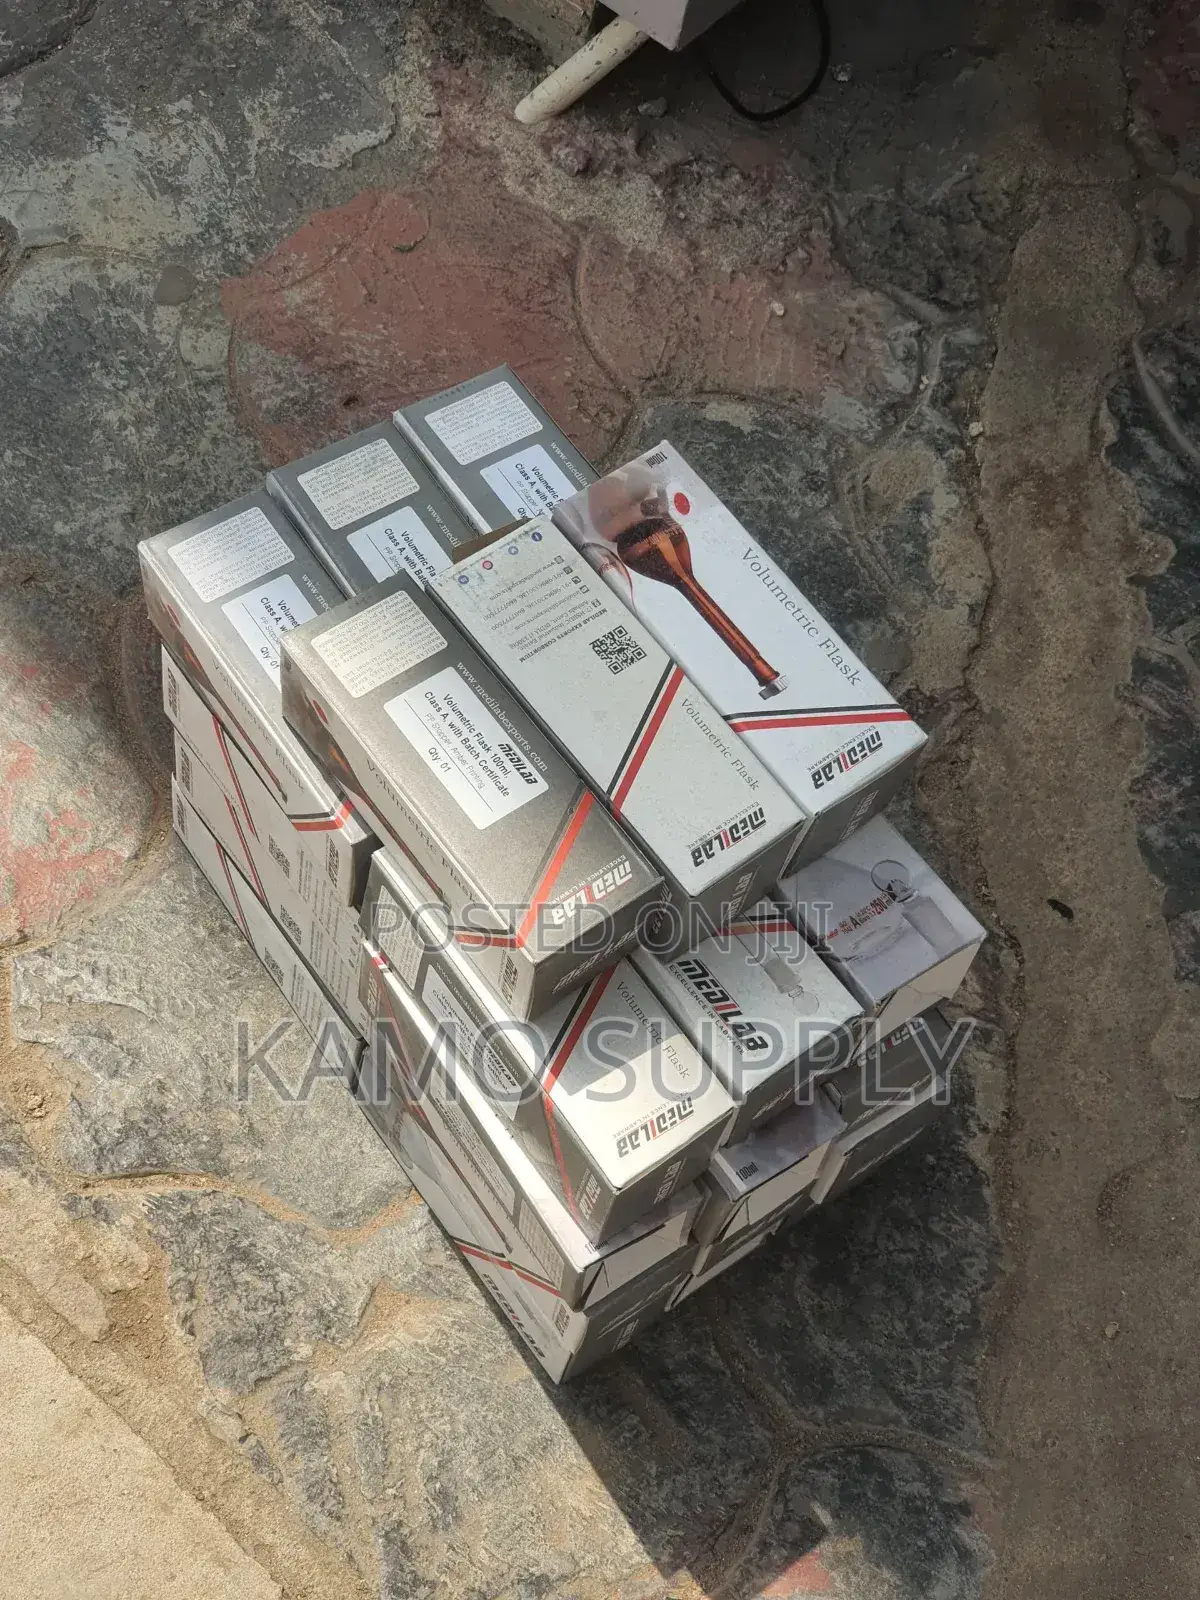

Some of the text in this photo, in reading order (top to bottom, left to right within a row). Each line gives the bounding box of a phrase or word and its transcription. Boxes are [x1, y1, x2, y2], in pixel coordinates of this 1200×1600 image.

[646, 451, 668, 468] 100ml
[515, 463, 531, 481] Class
[535, 488, 548, 503] with
[531, 465, 559, 499] Volumetric
[384, 528, 400, 547] Class
[404, 555, 417, 569] with
[400, 531, 428, 567] Volumetric
[260, 597, 277, 618] Class
[741, 547, 862, 687] Volumetric Flask
[443, 694, 512, 778] Volumetric Flask 100ml,
[456, 662, 548, 772] www.medilabexports.com
[424, 691, 510, 797] Class A, with Batch Certificate
[424, 712, 435, 724] PP
[451, 746, 470, 767] Amber
[466, 764, 486, 790] Printing
[428, 747, 452, 773] Qty: 01
[681, 698, 760, 792] Volumetric Flask
[849, 915, 862, 929] A
[669, 964, 708, 1011] EXCELLENCE
[706, 1006, 716, 1020] IN
[616, 981, 664, 1045] Volumetric
[662, 1044, 691, 1080] Flask
[735, 1161, 760, 1182] 100ml
